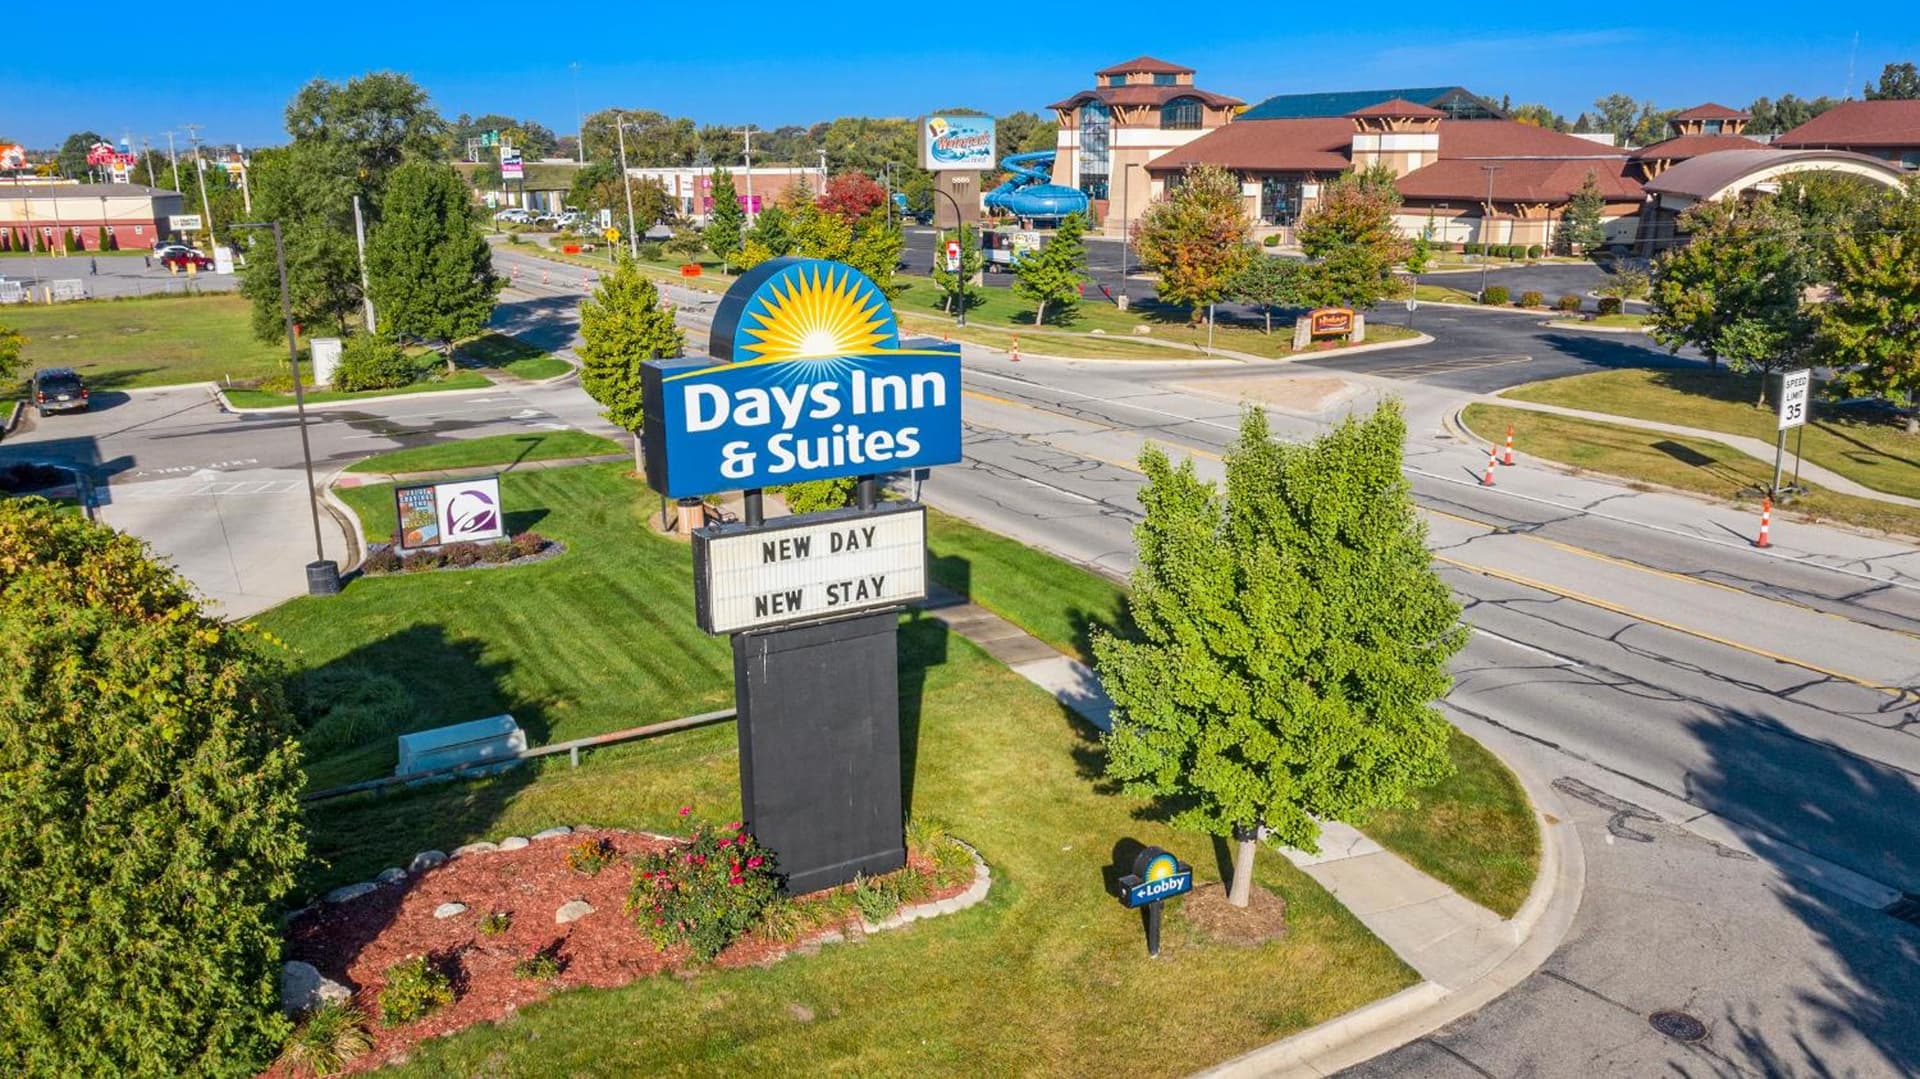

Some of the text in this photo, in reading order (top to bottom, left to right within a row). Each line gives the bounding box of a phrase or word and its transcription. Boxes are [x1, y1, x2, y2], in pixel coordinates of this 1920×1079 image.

[1786, 376, 1807, 389] SPEED
[1786, 390, 1803, 401] LIMIT
[684, 369, 946, 432] Days Inn
[1786, 403, 1802, 420] 35
[720, 424, 921, 479] & Suites
[762, 526, 876, 564] NEW DAY
[755, 576, 885, 617] NEW STAY
[1146, 877, 1185, 896] Lobby
